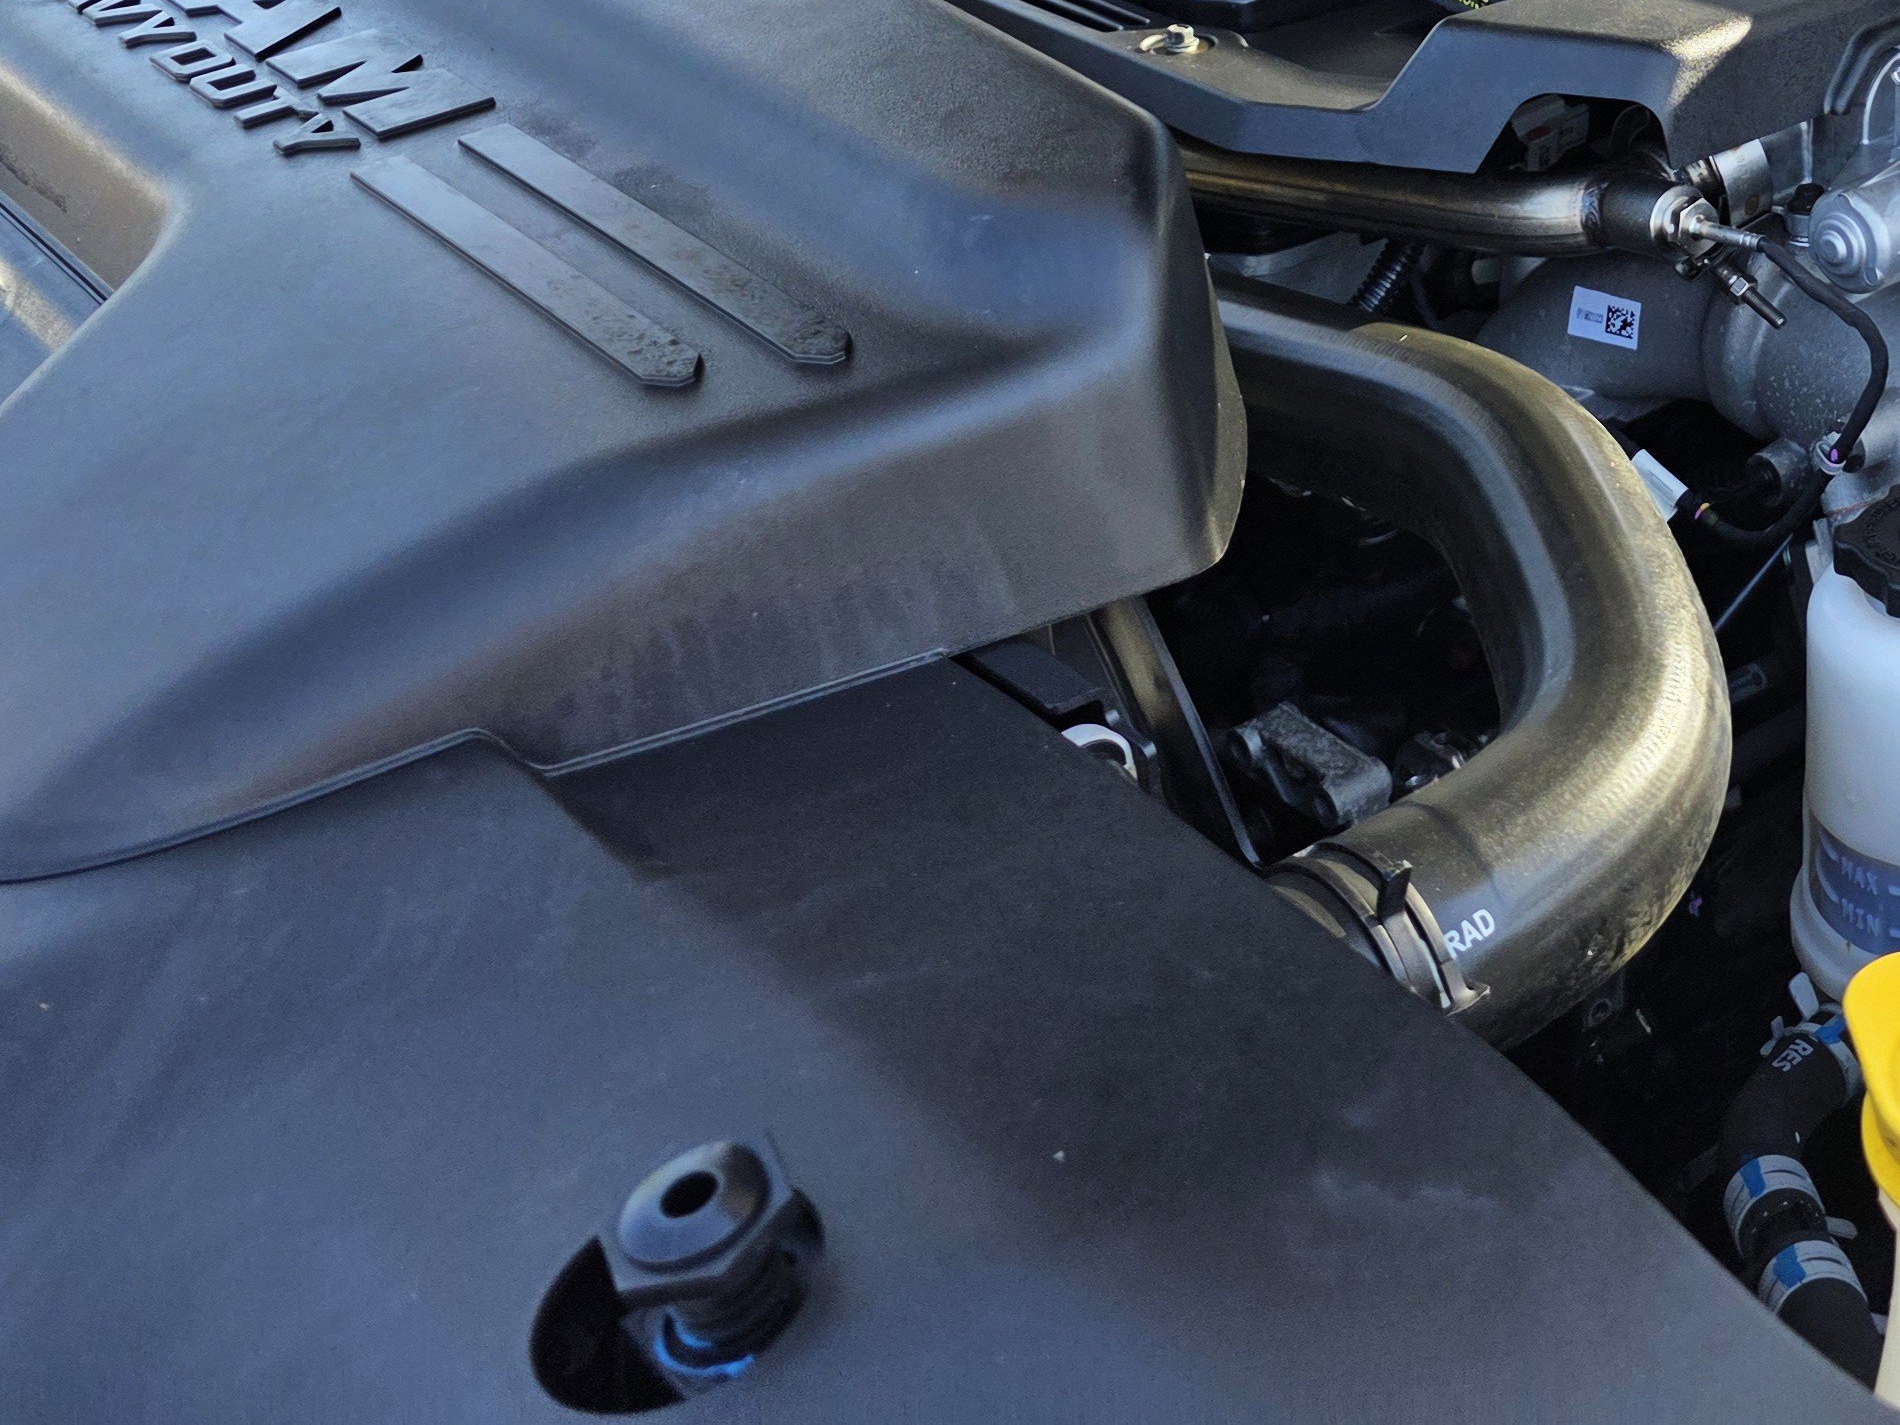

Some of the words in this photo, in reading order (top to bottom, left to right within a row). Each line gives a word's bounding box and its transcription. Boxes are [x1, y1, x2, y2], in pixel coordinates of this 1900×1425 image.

[149, 38, 362, 157] DUTY
[1841, 856, 1878, 896] MAX
[1444, 908, 1495, 961] RAD
[1841, 897, 1881, 938] MIN
[1772, 1038, 1814, 1073] RES
